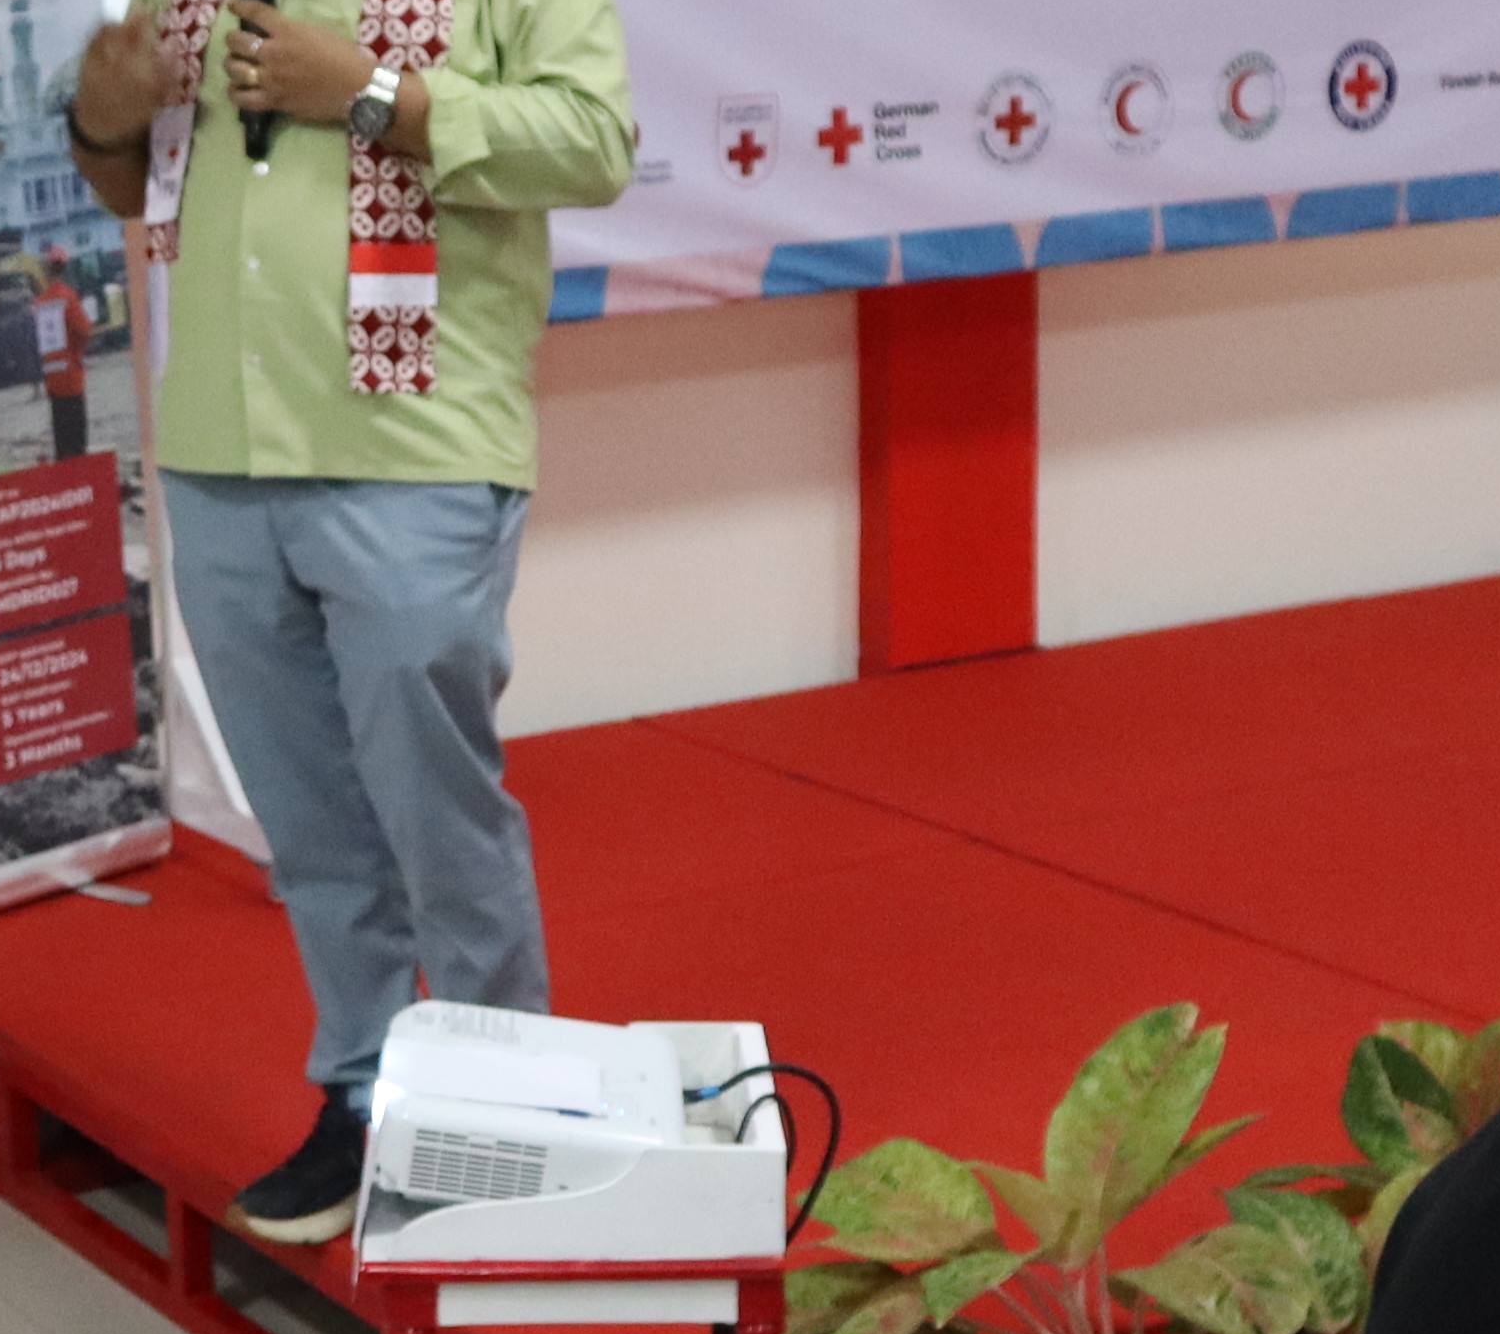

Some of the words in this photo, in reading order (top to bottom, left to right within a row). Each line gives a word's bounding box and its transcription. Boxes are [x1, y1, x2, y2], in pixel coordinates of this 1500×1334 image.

[873, 99, 940, 121] German
[875, 123, 908, 141] Red
[875, 142, 923, 163] Cross
